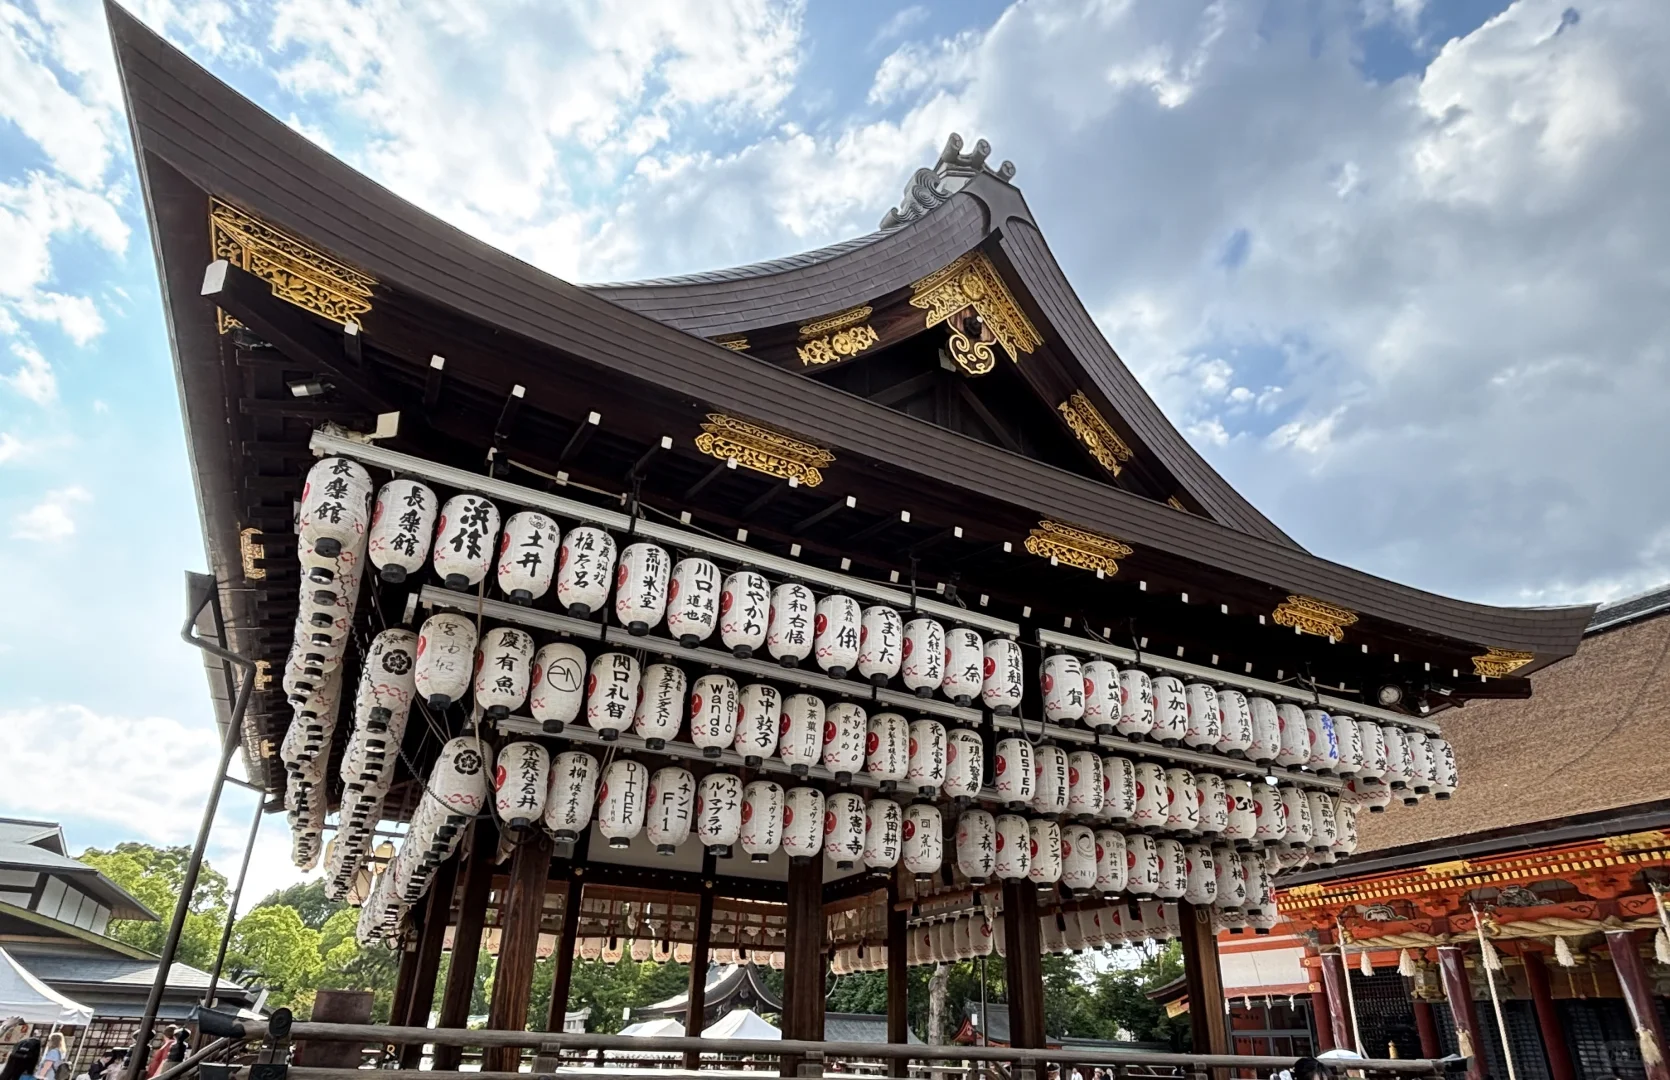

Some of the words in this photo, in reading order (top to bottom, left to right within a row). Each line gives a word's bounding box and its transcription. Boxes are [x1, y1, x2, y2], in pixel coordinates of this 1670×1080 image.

[450, 499, 493, 560] 浜作
[517, 530, 544, 577] 土井
[695, 563, 713, 593] 川口
[684, 595, 701, 621] 道也
[744, 575, 765, 636] はやかわ
[785, 585, 808, 644] 名和右悟
[492, 630, 521, 696] 慶有魚
[878, 609, 897, 664] やました
[924, 620, 941, 680] たん熊北店
[604, 654, 630, 720] 関口礼智
[724, 679, 736, 734] Magic
[1065, 659, 1083, 707] 三賀
[1168, 680, 1187, 732] 山加代
[710, 684, 724, 737] Wands
[754, 687, 777, 748] 田中敦子
[804, 709, 817, 758] 茶菓円山
[841, 714, 852, 751] 京あめ
[851, 707, 861, 762] kyoto
[622, 763, 637, 825] DITREK
[725, 776, 738, 810] サウナ
[965, 745, 982, 792] 現代警備
[1018, 740, 1030, 796] NOSTER
[1054, 749, 1066, 806] NOSTER
[1153, 766, 1168, 816] おいと
[708, 781, 725, 836] ルーマプラザ
[764, 792, 776, 845] ジュヴァンセル
[805, 799, 818, 849] ジュヴァンセル
[1182, 772, 1199, 822] おいと
[847, 798, 864, 856] 弘憲寺
[882, 804, 898, 860] 森田耕司
[979, 834, 994, 872] 森幸
[1016, 834, 1030, 872] 森幸
